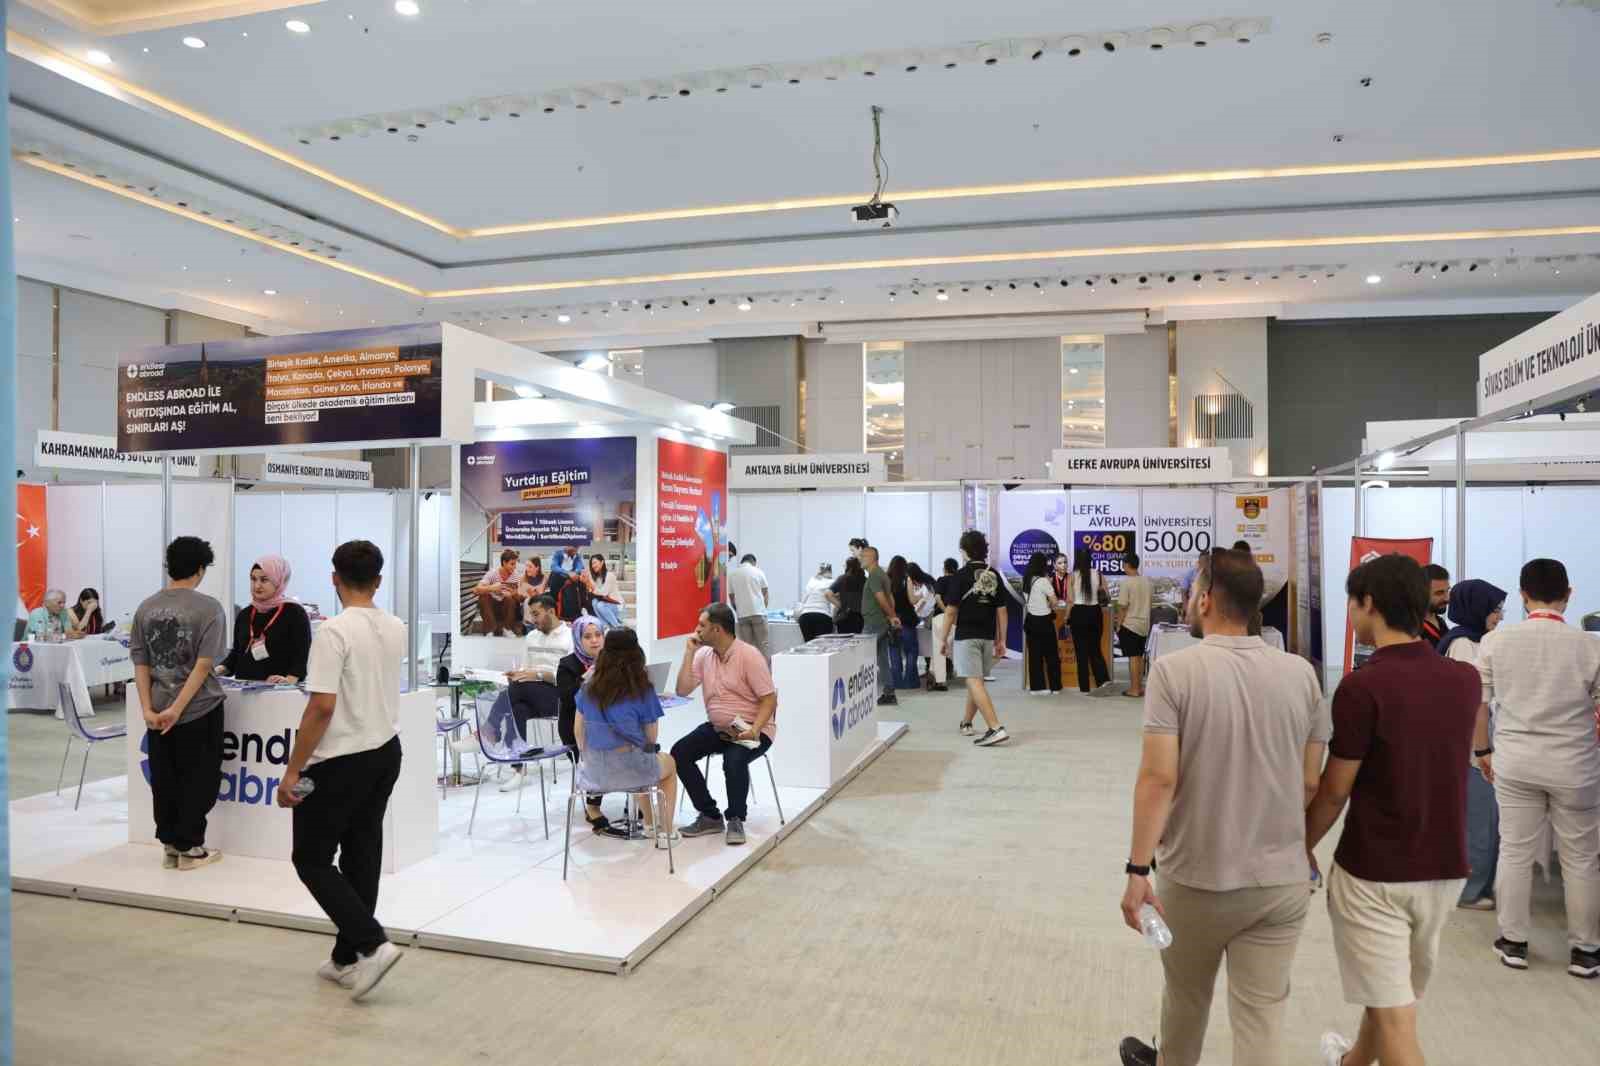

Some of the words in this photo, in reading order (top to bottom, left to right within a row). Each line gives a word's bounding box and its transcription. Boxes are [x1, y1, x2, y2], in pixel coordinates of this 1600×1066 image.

[1504, 359, 1524, 390] BİLİM
[1525, 355, 1536, 381] VE
[1537, 327, 1584, 376] TEKNOLOJİ
[126, 390, 165, 402] ENDLESS
[167, 387, 206, 400] ABROAD
[208, 384, 222, 397] İLE
[319, 396, 357, 407] akademik
[359, 395, 385, 407] eğitim
[127, 405, 186, 419] YURTDIŞINDA
[188, 400, 220, 415] EĞİTİM
[222, 402, 237, 414] AL,
[126, 421, 169, 434] SINIRLARI
[170, 420, 186, 434] AŞ!
[300, 466, 323, 477] KORKUT
[324, 467, 335, 477] ATA
[745, 464, 781, 475] ANTALYA
[783, 463, 807, 475] BİLİM
[809, 461, 870, 474] ÜNİVERSİTESİ
[1068, 458, 1097, 470] LEFKE
[1100, 457, 1140, 469] AVRUPA
[1142, 456, 1211, 469] ÜNİVERSİTESİ
[505, 474, 548, 488] Yurtdışı
[551, 469, 588, 485] Eğitim
[1072, 504, 1111, 515] LEFKE
[1088, 516, 1136, 527] AVRUPA
[1144, 516, 1211, 527] ÜNİVERSİTESİ
[1082, 534, 1126, 551] %80
[1144, 531, 1211, 552] 5000
[848, 663, 875, 699] endless
[848, 692, 874, 729] abroad
